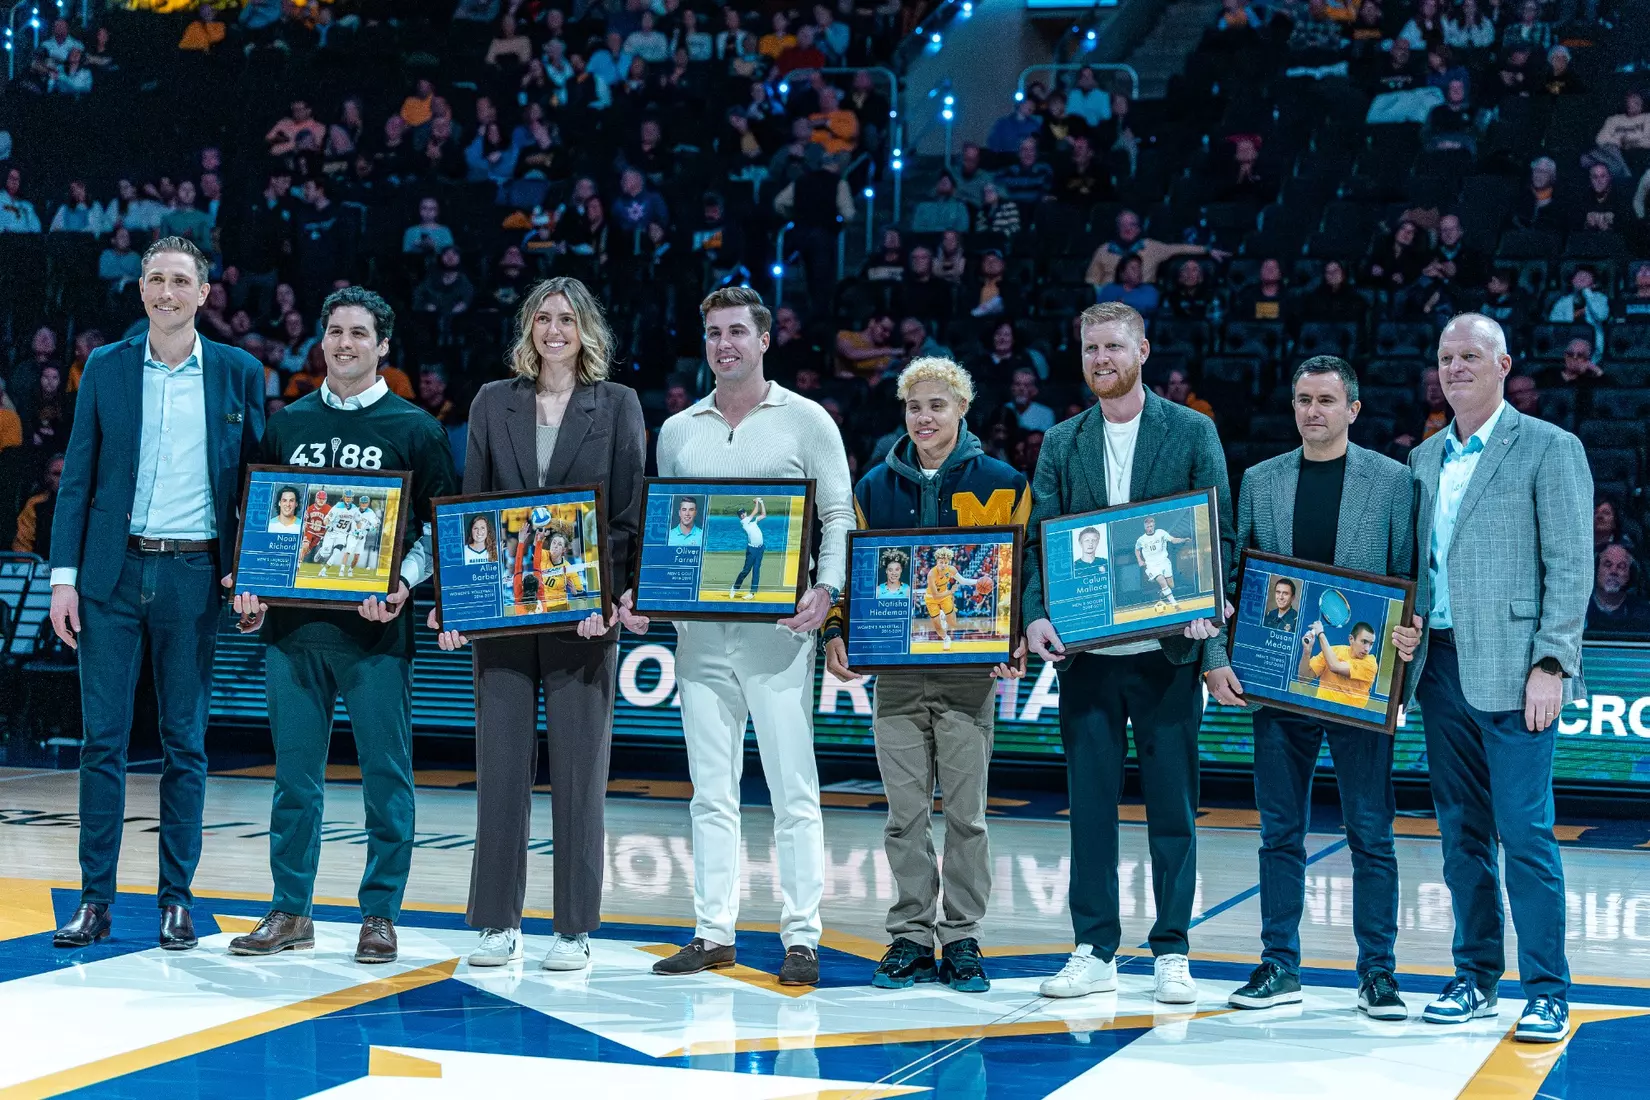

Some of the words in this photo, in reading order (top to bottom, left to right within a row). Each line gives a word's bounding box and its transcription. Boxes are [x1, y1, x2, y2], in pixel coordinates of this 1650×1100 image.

[289, 442, 327, 468] 43
[339, 443, 383, 470] 88
[952, 488, 1017, 527] M
[276, 534, 297, 542] Noah
[268, 541, 297, 551] Richard
[675, 546, 699, 555] Oliver
[674, 555, 699, 563] Farrell
[479, 563, 498, 572] Allie
[1082, 575, 1108, 585] Calum
[878, 600, 908, 608] Natisha
[869, 608, 908, 616] Hiedeman
[1269, 630, 1293, 642] Dusan
[1264, 639, 1292, 651] Medan
